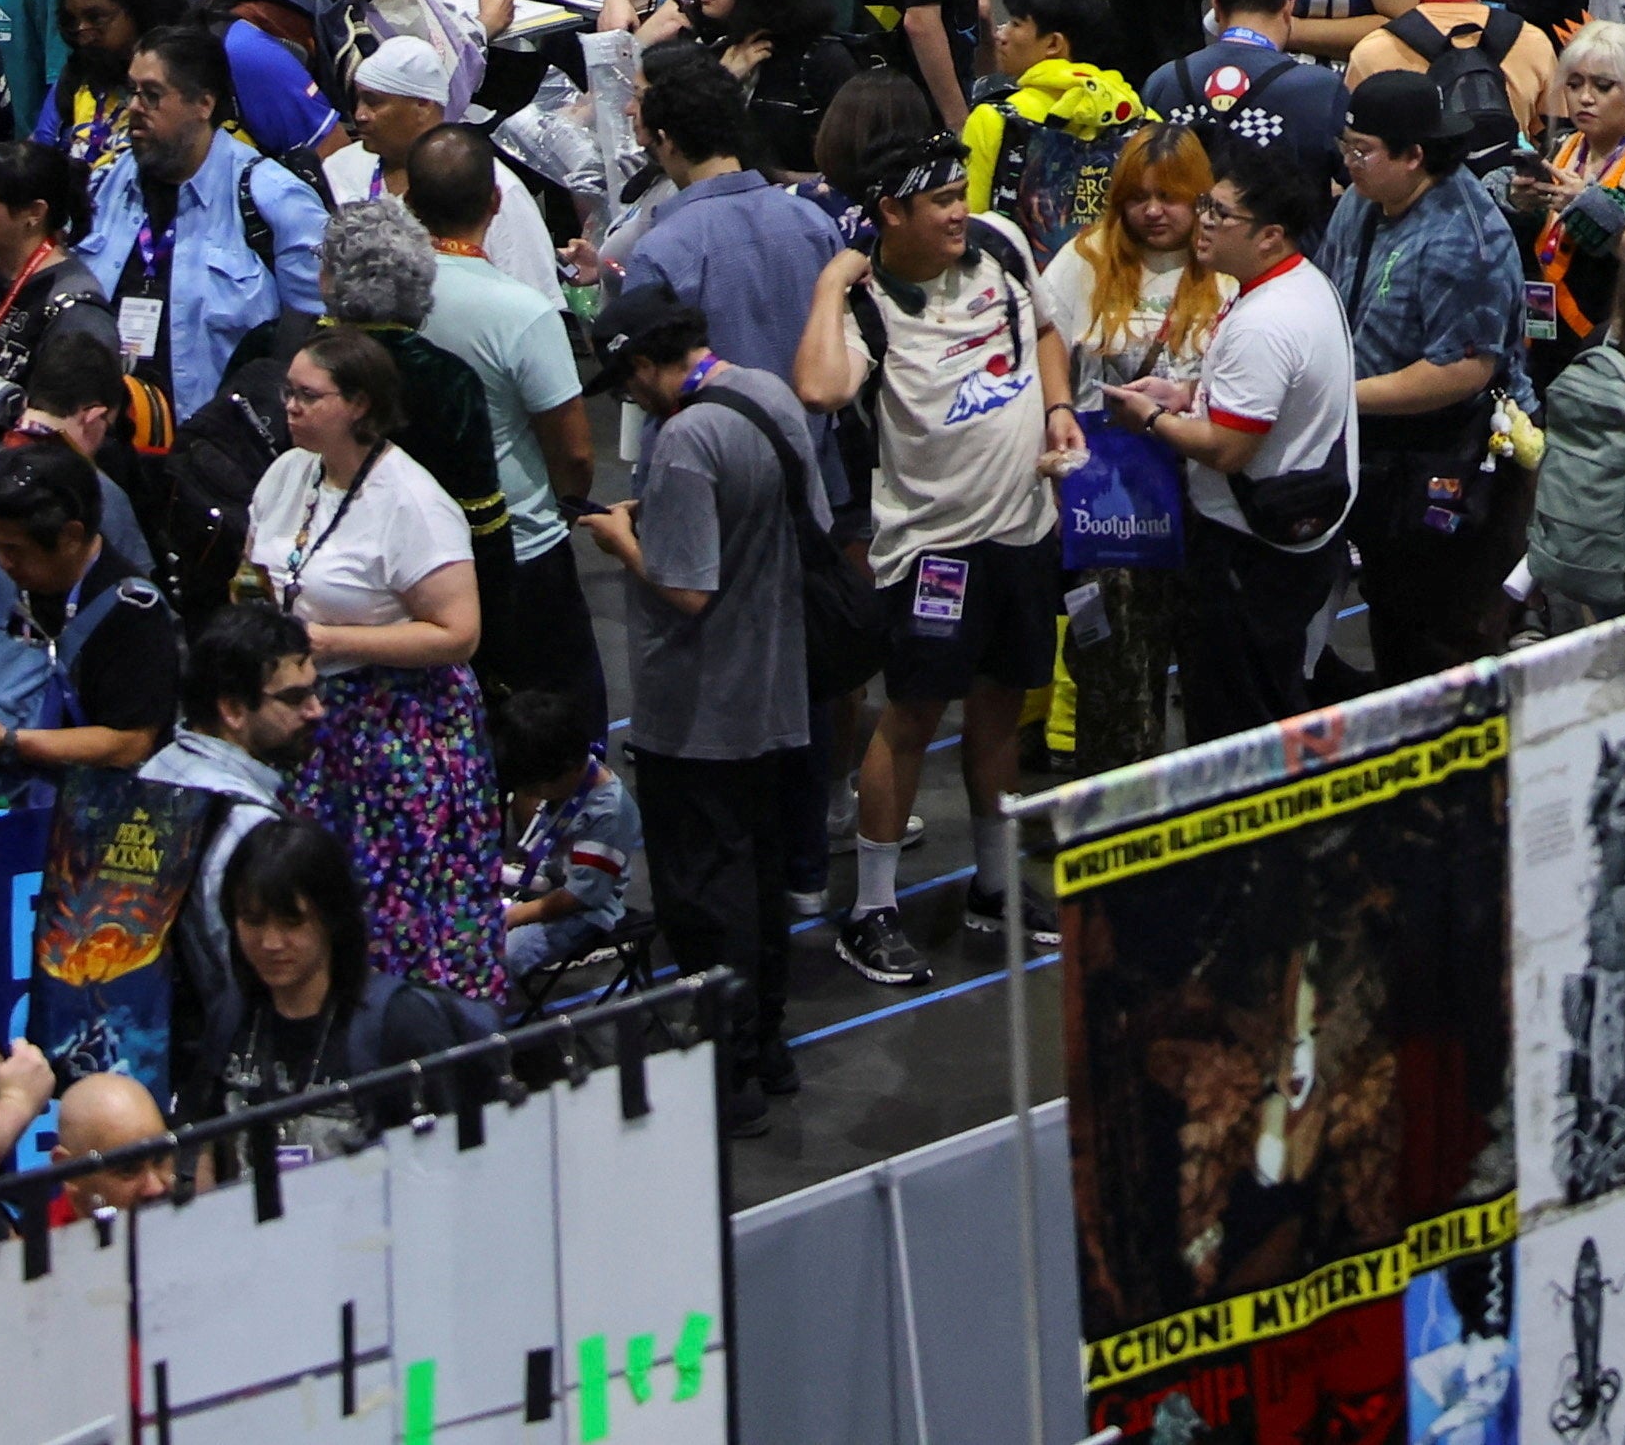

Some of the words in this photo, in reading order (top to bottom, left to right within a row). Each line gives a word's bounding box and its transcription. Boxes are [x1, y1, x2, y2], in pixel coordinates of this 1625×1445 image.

[1072, 506, 1171, 540] Bootyland
[102, 843, 165, 873] JACKSON
[1064, 833, 1163, 884] WRITING
[1167, 797, 1325, 849] ILLUSTRATION
[1331, 751, 1421, 804] GRAPHIC
[1088, 1308, 1235, 1380] ACTION!
[1253, 1247, 1409, 1333] MYSTERY!
